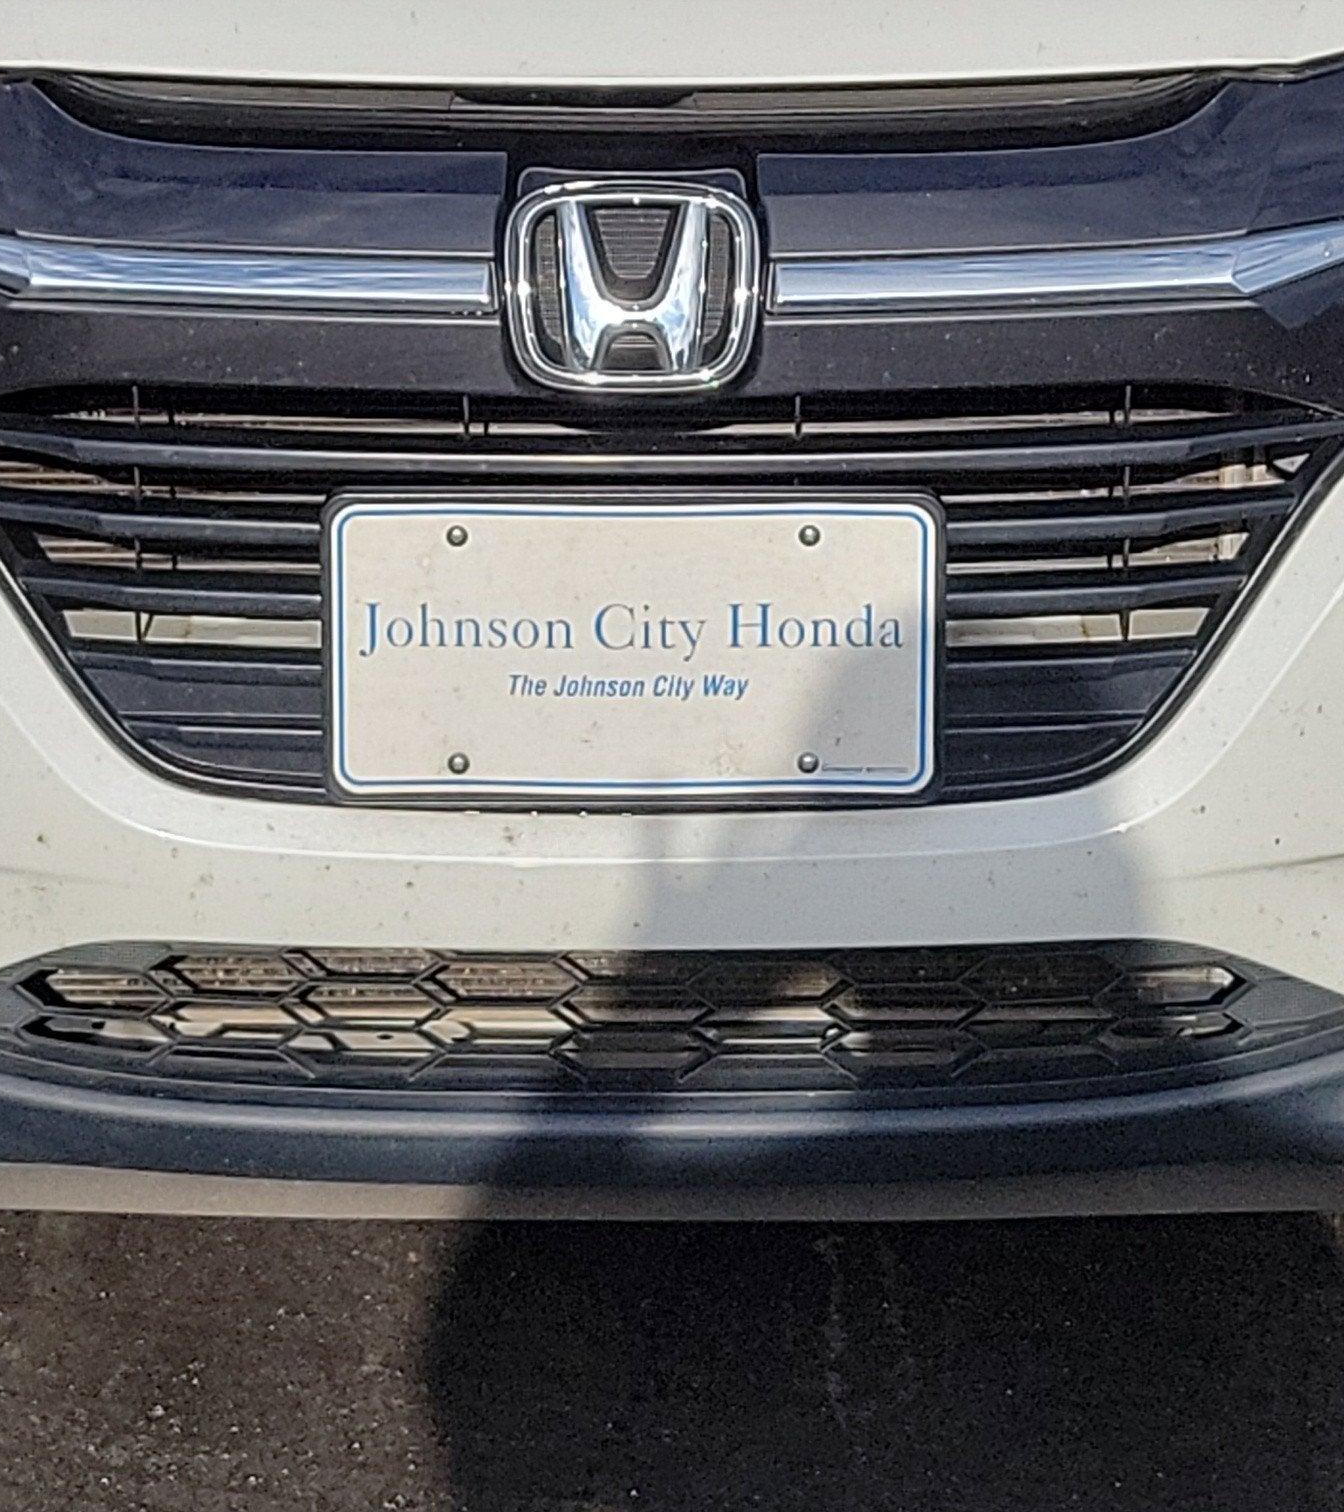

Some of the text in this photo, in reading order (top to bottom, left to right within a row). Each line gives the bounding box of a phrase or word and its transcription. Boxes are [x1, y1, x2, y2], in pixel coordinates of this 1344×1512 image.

[358, 602, 904, 662] Johnson City Honda
[508, 673, 750, 701] The Johnson City Way
